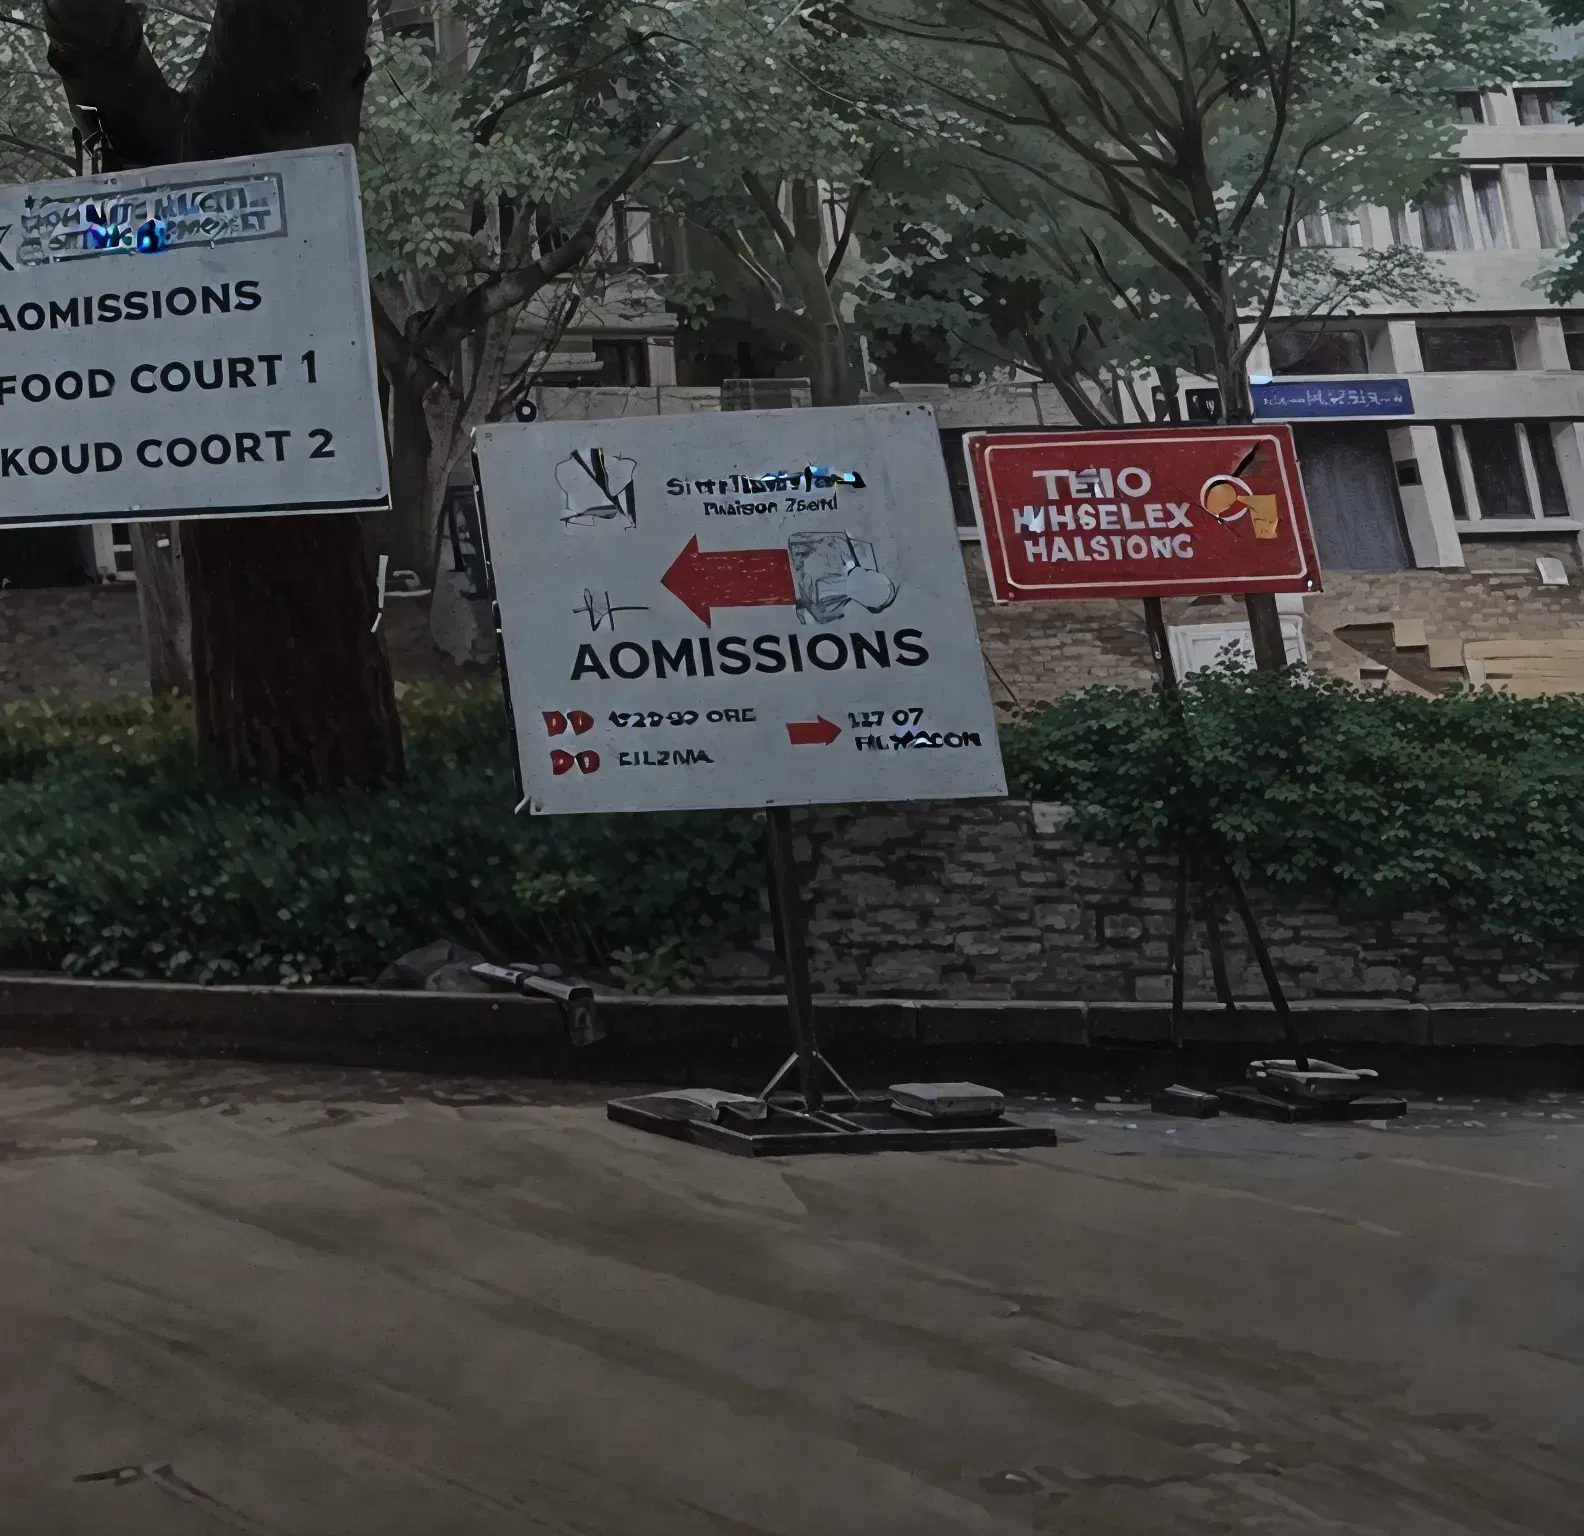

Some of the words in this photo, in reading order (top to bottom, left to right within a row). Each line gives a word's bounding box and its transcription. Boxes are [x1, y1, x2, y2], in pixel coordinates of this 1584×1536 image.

[130, 353, 283, 394] COURT
[301, 349, 317, 384] 1
[0, 441, 123, 478] KOUD
[136, 430, 292, 469] COORT
[307, 428, 336, 459] 2
